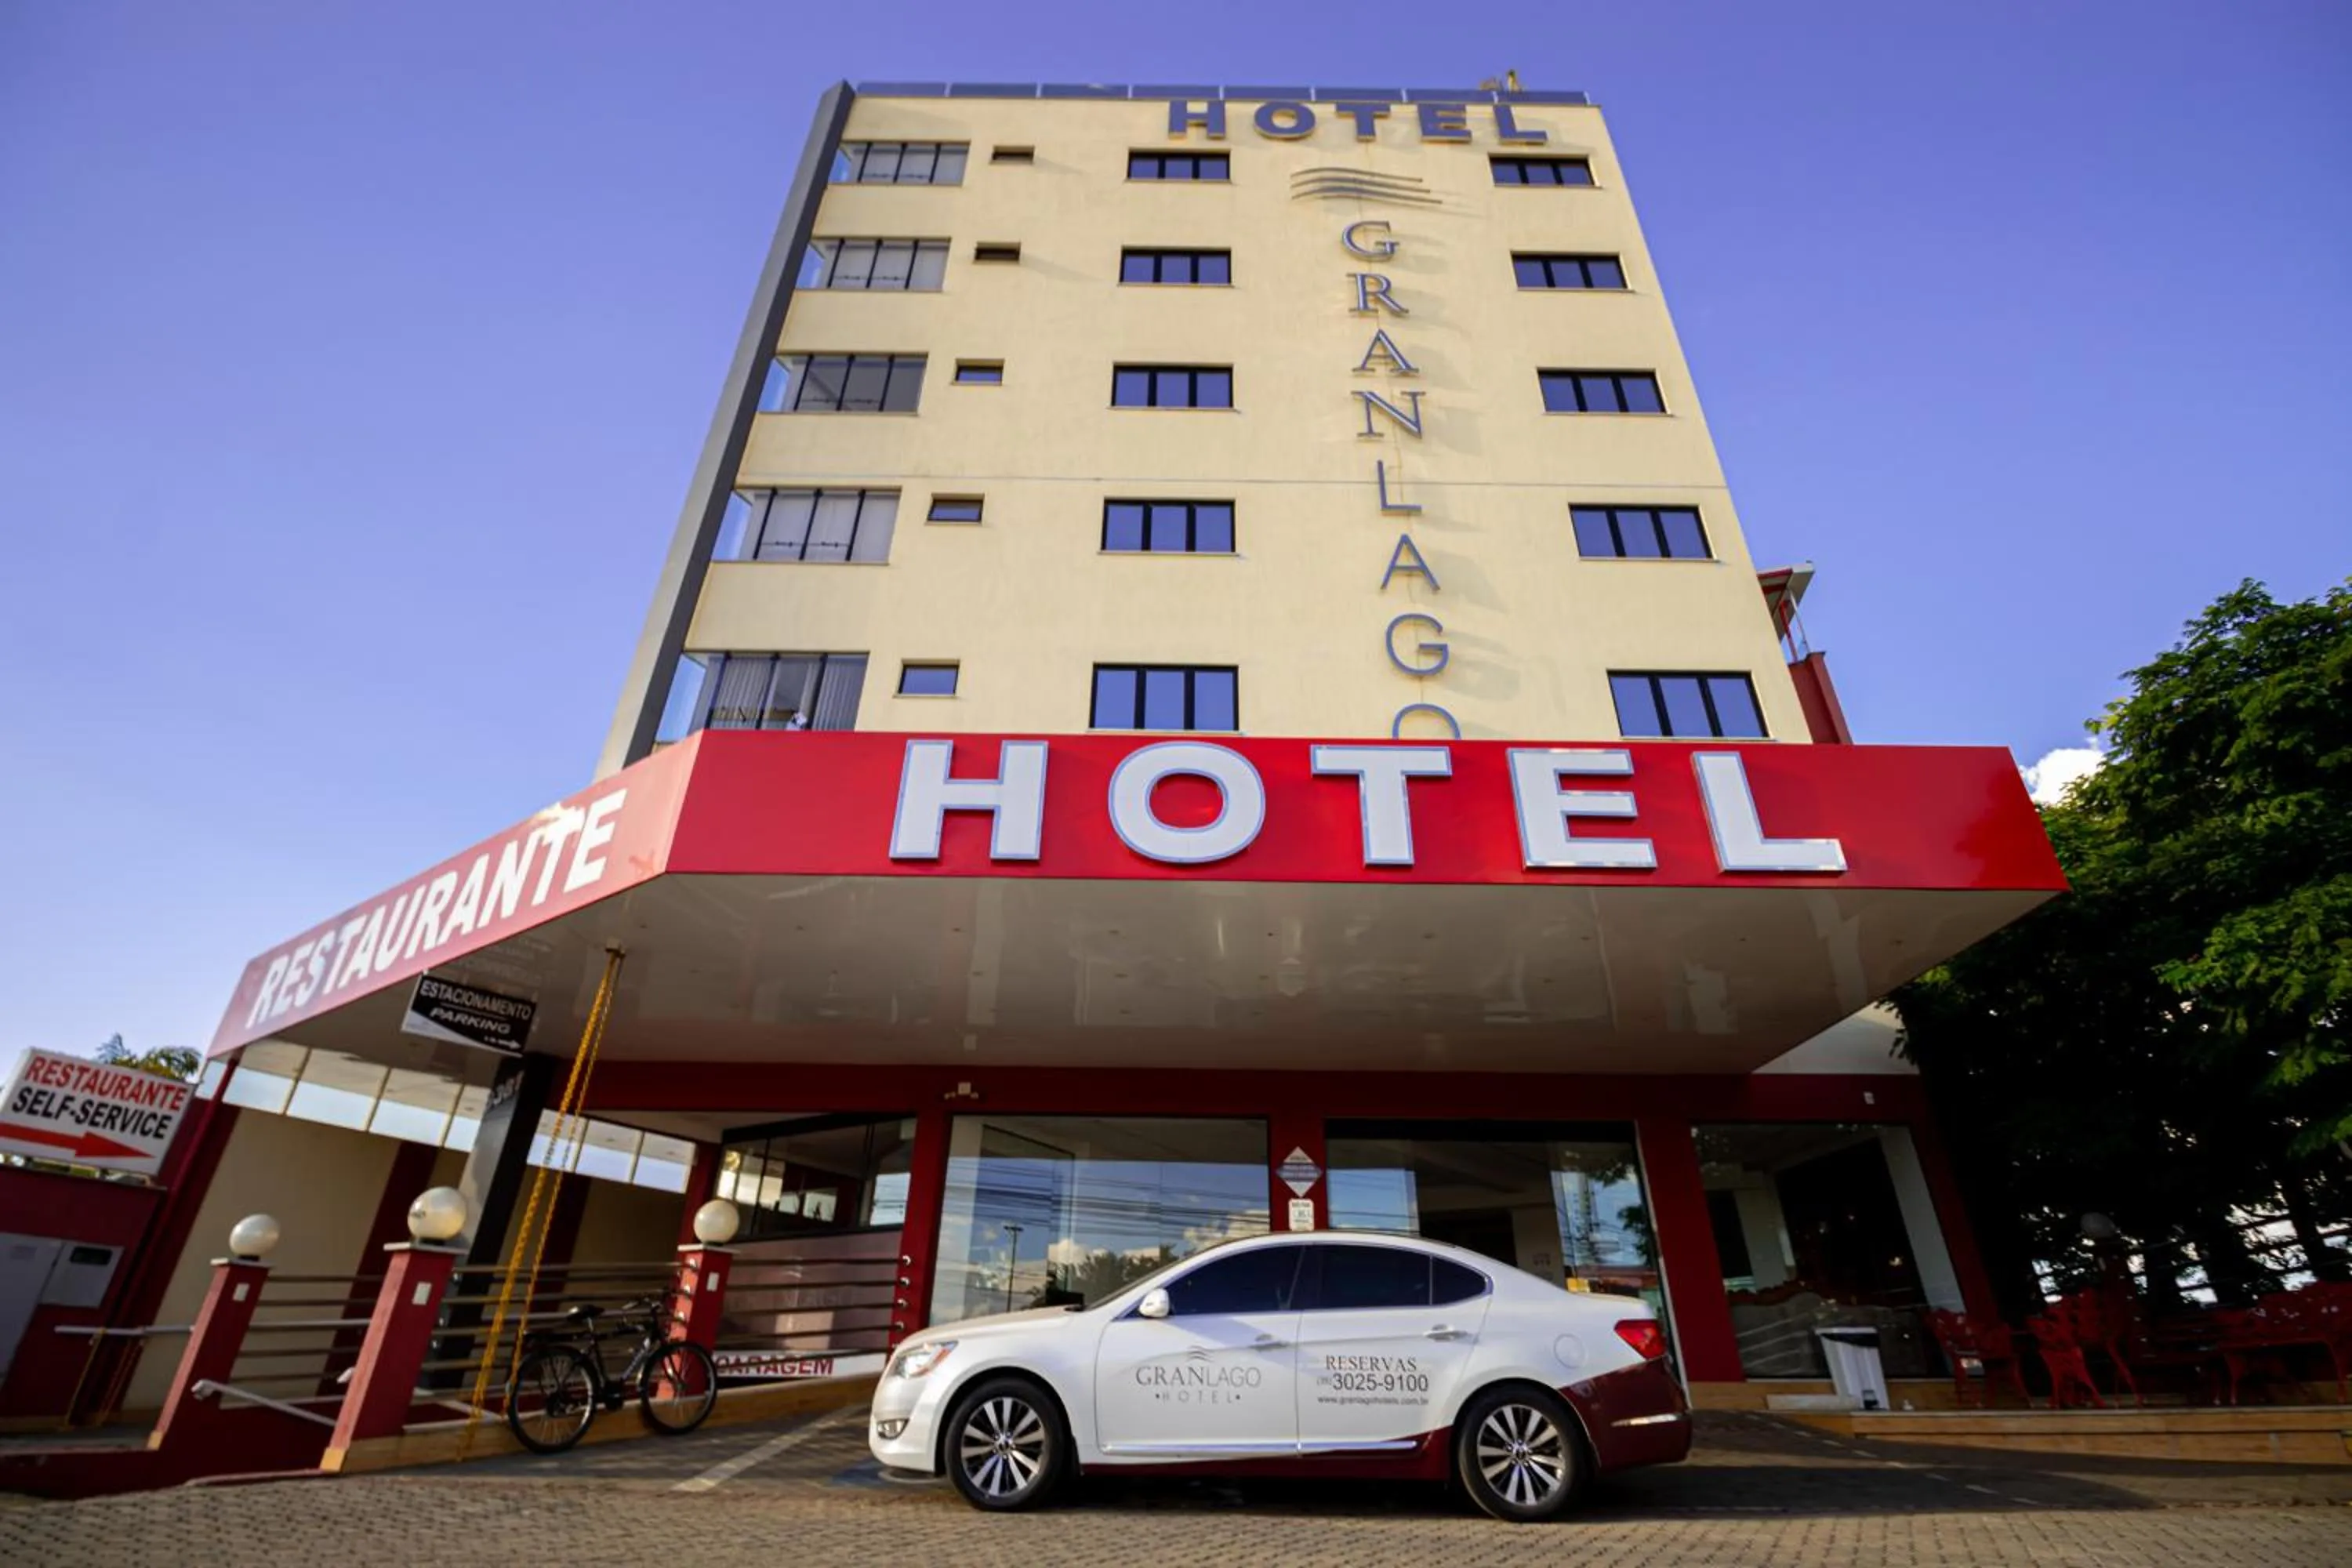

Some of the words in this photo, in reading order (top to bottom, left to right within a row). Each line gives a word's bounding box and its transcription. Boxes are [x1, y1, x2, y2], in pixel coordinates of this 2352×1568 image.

[1167, 100, 1548, 145] HOTEL
[889, 739, 1848, 873] HOTEL
[245, 788, 627, 1029] RESTAURANTE
[419, 981, 532, 1020] ESTACIONAMENTO
[430, 1007, 511, 1034] PARKING
[24, 1055, 187, 1112] RESTAURANTE
[12, 1086, 172, 1139] SELF-SERVICE
[1136, 1366, 1261, 1388] GRANLAGO
[1325, 1354, 1417, 1372] RESERVAS
[1333, 1373, 1428, 1392] 3025-9100
